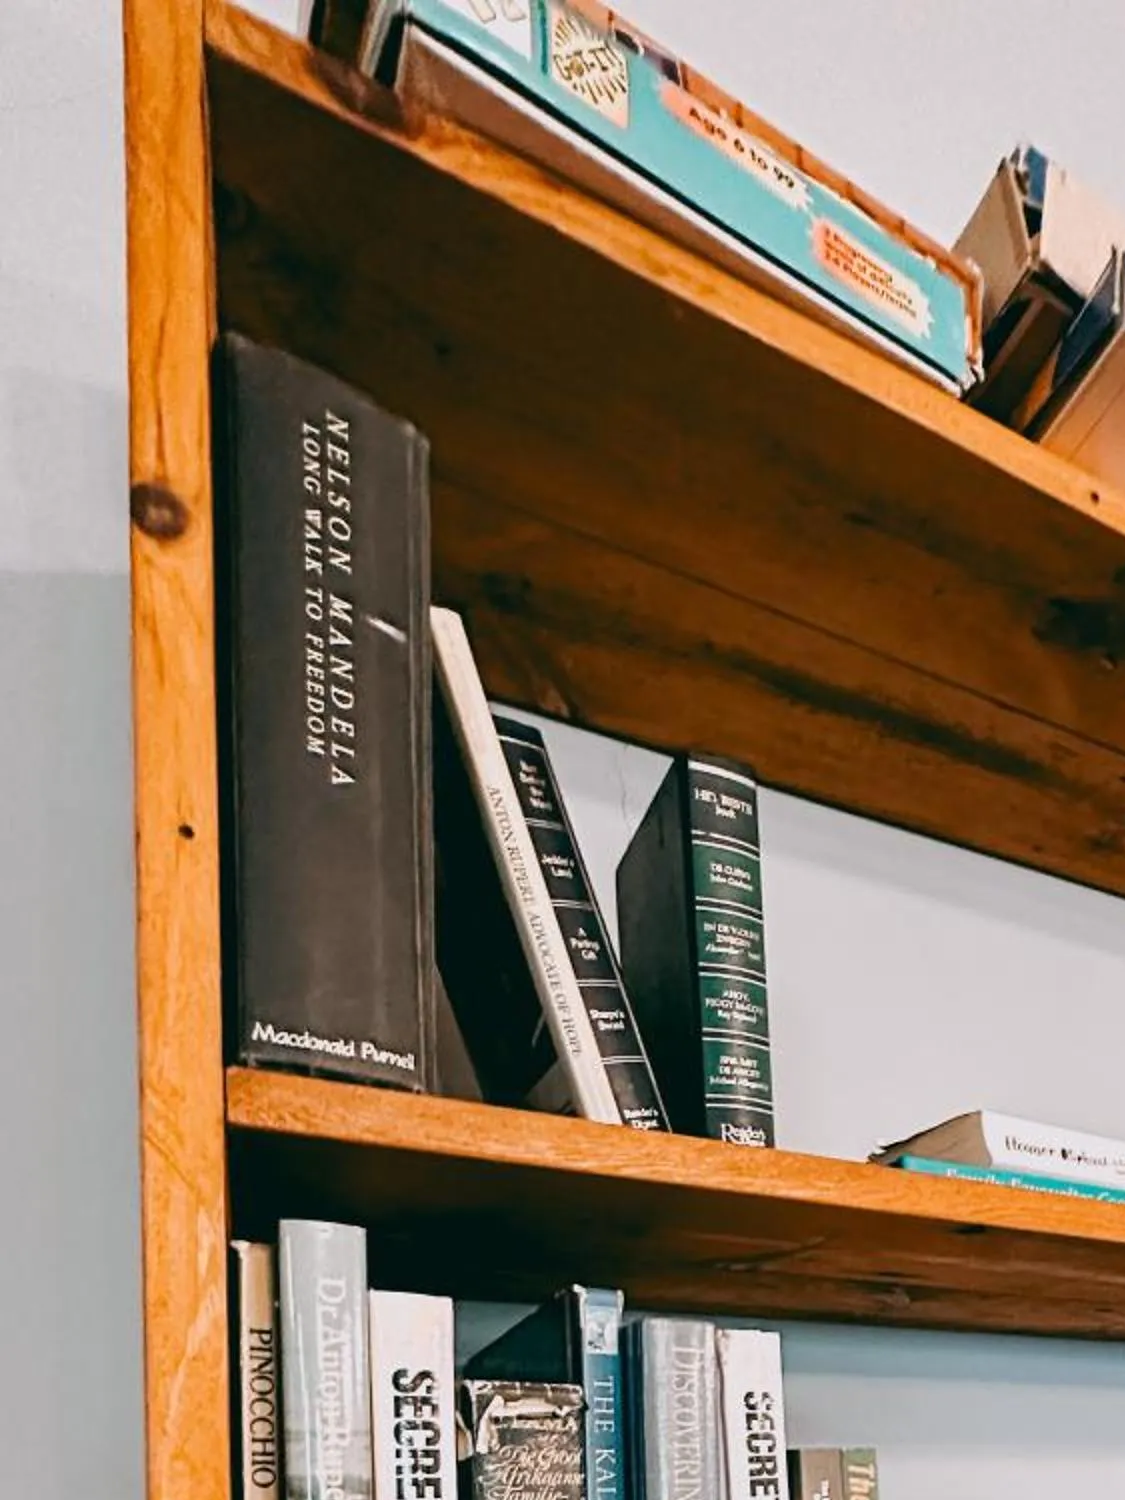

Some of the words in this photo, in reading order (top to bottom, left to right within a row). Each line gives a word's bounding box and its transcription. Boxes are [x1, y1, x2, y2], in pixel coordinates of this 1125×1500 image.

[690, 107, 727, 141] Age
[734, 138, 744, 153] 6
[749, 149, 768, 171] to
[773, 165, 795, 189] 99
[302, 421, 321, 496] LONG
[326, 408, 352, 575] NELSON
[305, 508, 323, 576] WALK
[305, 587, 323, 620] TO
[305, 634, 326, 757] FREEDOM
[329, 593, 356, 787] MANDELA
[489, 785, 515, 843] ANTON
[508, 845, 533, 903] RUPERT
[527, 911, 562, 991] ADVOCATE
[553, 991, 571, 1016] OF
[562, 1016, 581, 1056] HOPE
[251, 1020, 355, 1058] Macdonald
[360, 1041, 416, 1071] Purnell
[318, 1277, 346, 1312] Dr
[248, 1327, 277, 1490] PINOCCHIO
[317, 1322, 352, 1422] Anton
[593, 1375, 615, 1433] THE
[537, 1446, 582, 1471] Groot
